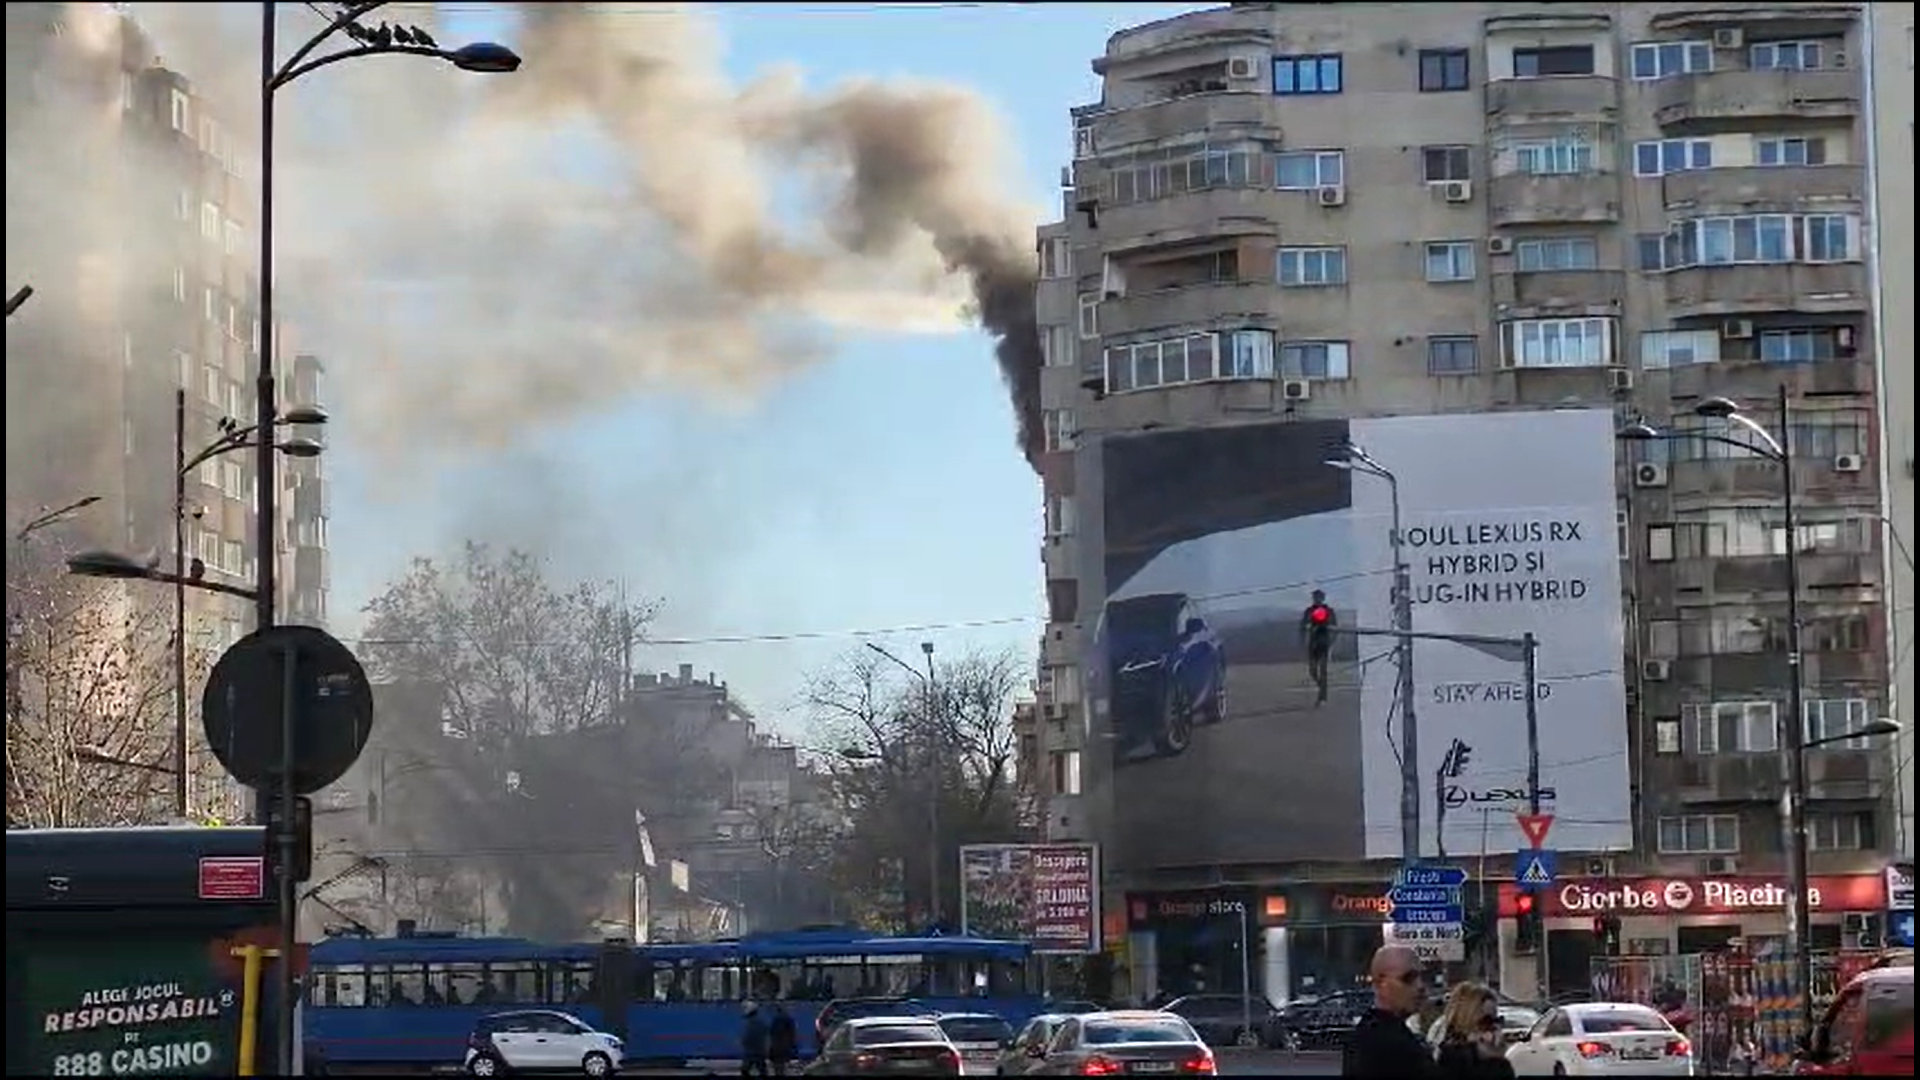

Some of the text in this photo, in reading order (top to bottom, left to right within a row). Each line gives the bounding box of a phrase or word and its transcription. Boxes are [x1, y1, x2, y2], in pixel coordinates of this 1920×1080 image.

[1389, 521, 1582, 547] NOUL LEXUS RX
[1428, 553, 1518, 575] HYBRID
[1495, 579, 1587, 601] HYBRID
[1432, 682, 1552, 703] STAY AHED
[1208, 897, 1243, 914] store
[1560, 883, 1659, 910] Ciorbe
[82, 982, 183, 1007] ALEGE JOCUL
[44, 997, 218, 1034] RESPONSABIL
[54, 1041, 212, 1077] 888 CASINO
